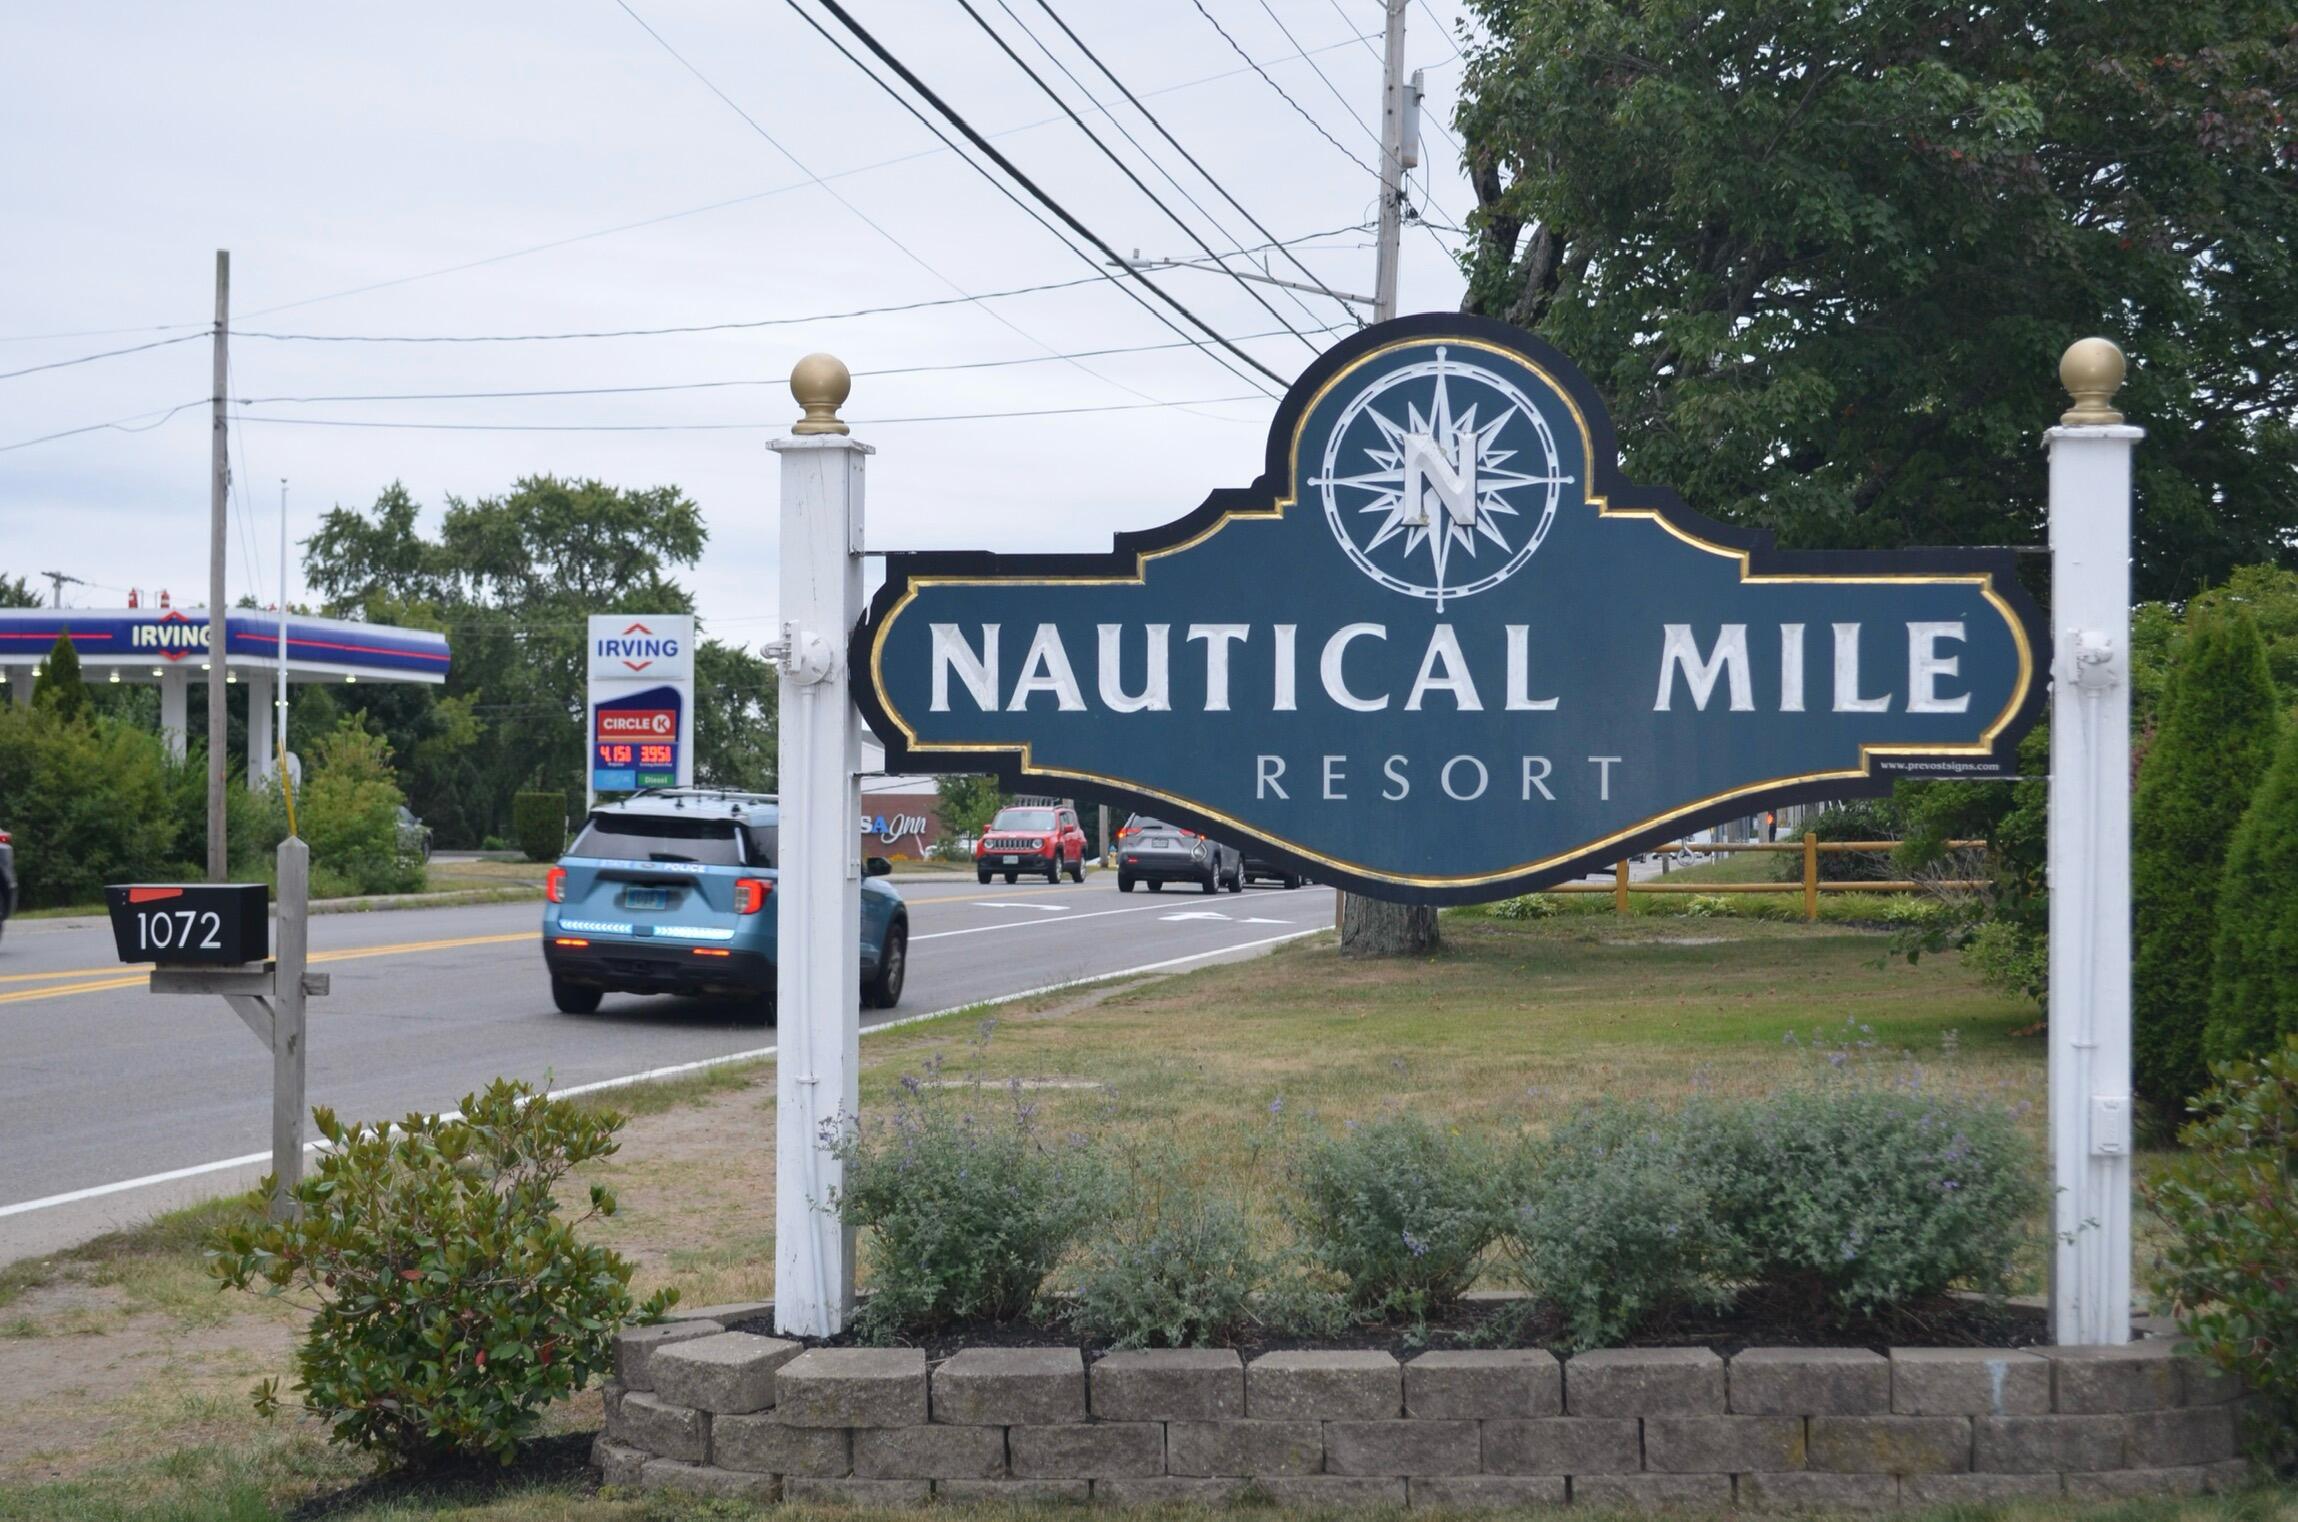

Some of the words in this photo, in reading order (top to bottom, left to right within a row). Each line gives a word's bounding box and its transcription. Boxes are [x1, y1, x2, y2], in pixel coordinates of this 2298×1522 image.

[1401, 432, 1478, 527] N
[598, 639, 679, 657] IRVING
[929, 622, 1560, 714] NAUTICAL
[1653, 620, 1970, 714] MILE
[603, 717, 650, 730] CIRCLE
[1257, 754, 1622, 802] RESORT
[1880, 761, 1999, 772] www.prevostsigns.com
[663, 861, 705, 873] POLICE
[137, 911, 221, 950] 1072
